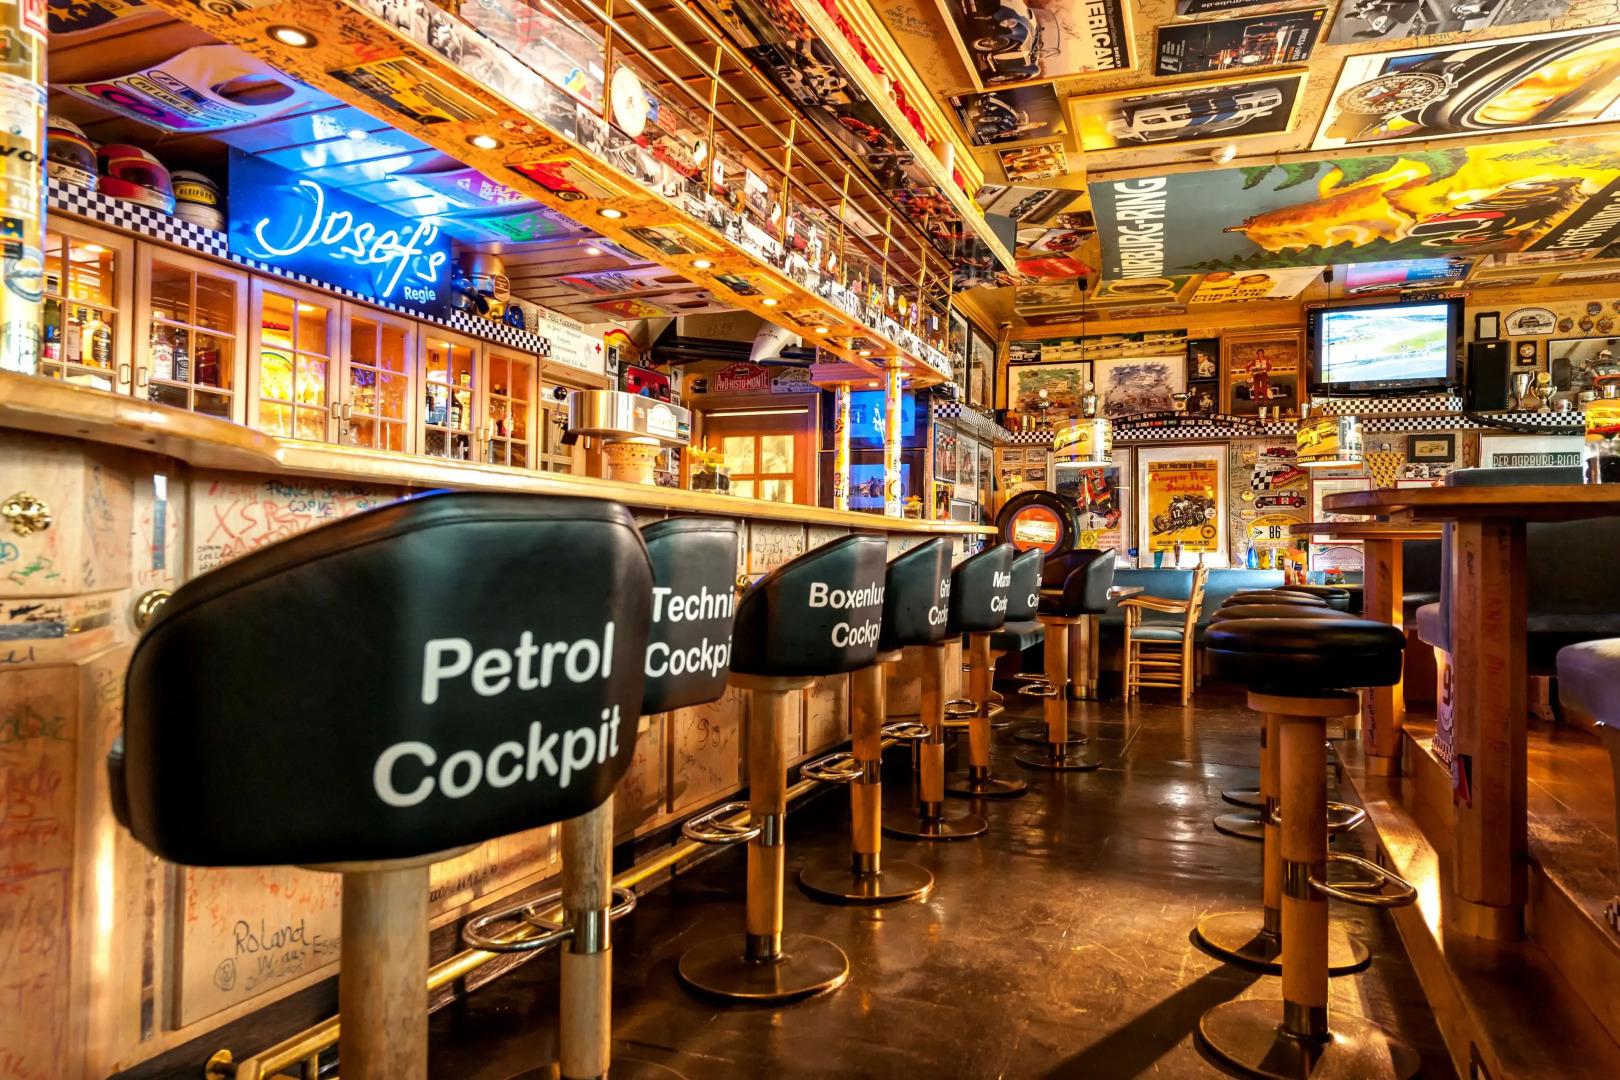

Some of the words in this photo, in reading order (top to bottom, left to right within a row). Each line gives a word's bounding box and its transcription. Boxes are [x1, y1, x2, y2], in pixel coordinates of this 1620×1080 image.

[1113, 177, 1167, 280] NÜRBURG-RING
[404, 286, 437, 304] Regie
[1269, 525, 1281, 539] 86
[421, 621, 616, 705] Petrol
[372, 704, 621, 807] Cockpit
[233, 917, 311, 959] Roland
